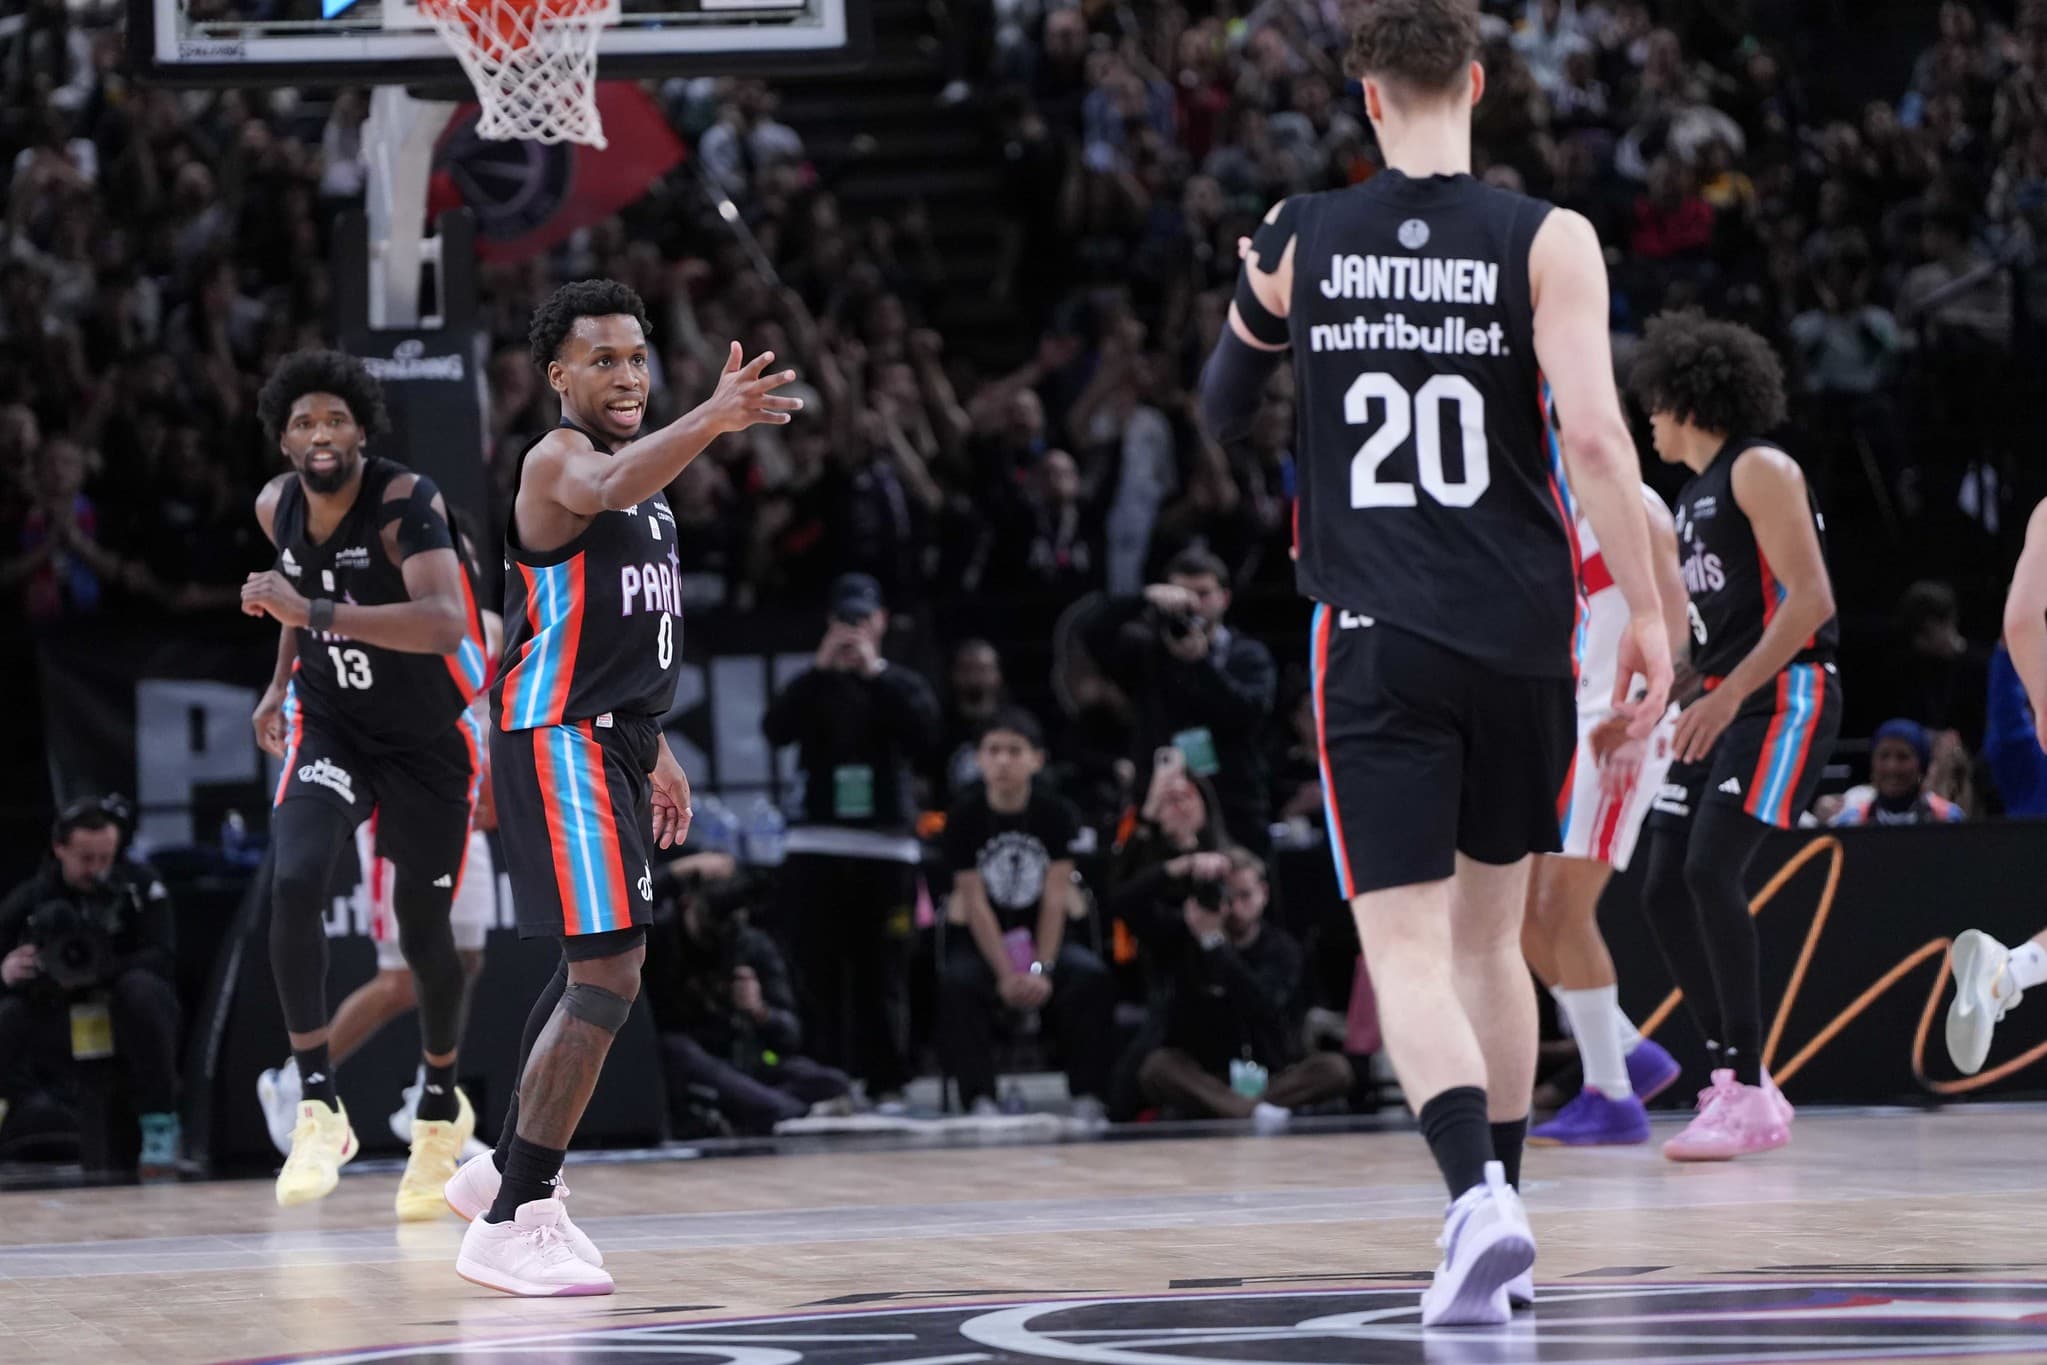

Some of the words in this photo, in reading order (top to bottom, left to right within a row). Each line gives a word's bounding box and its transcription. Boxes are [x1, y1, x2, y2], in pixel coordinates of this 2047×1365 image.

[1320, 254, 1499, 305] JANTUNEN
[1344, 372, 1490, 509] 20
[621, 561, 682, 617] PARI
[328, 645, 373, 690] 13
[658, 611, 673, 670] 0
